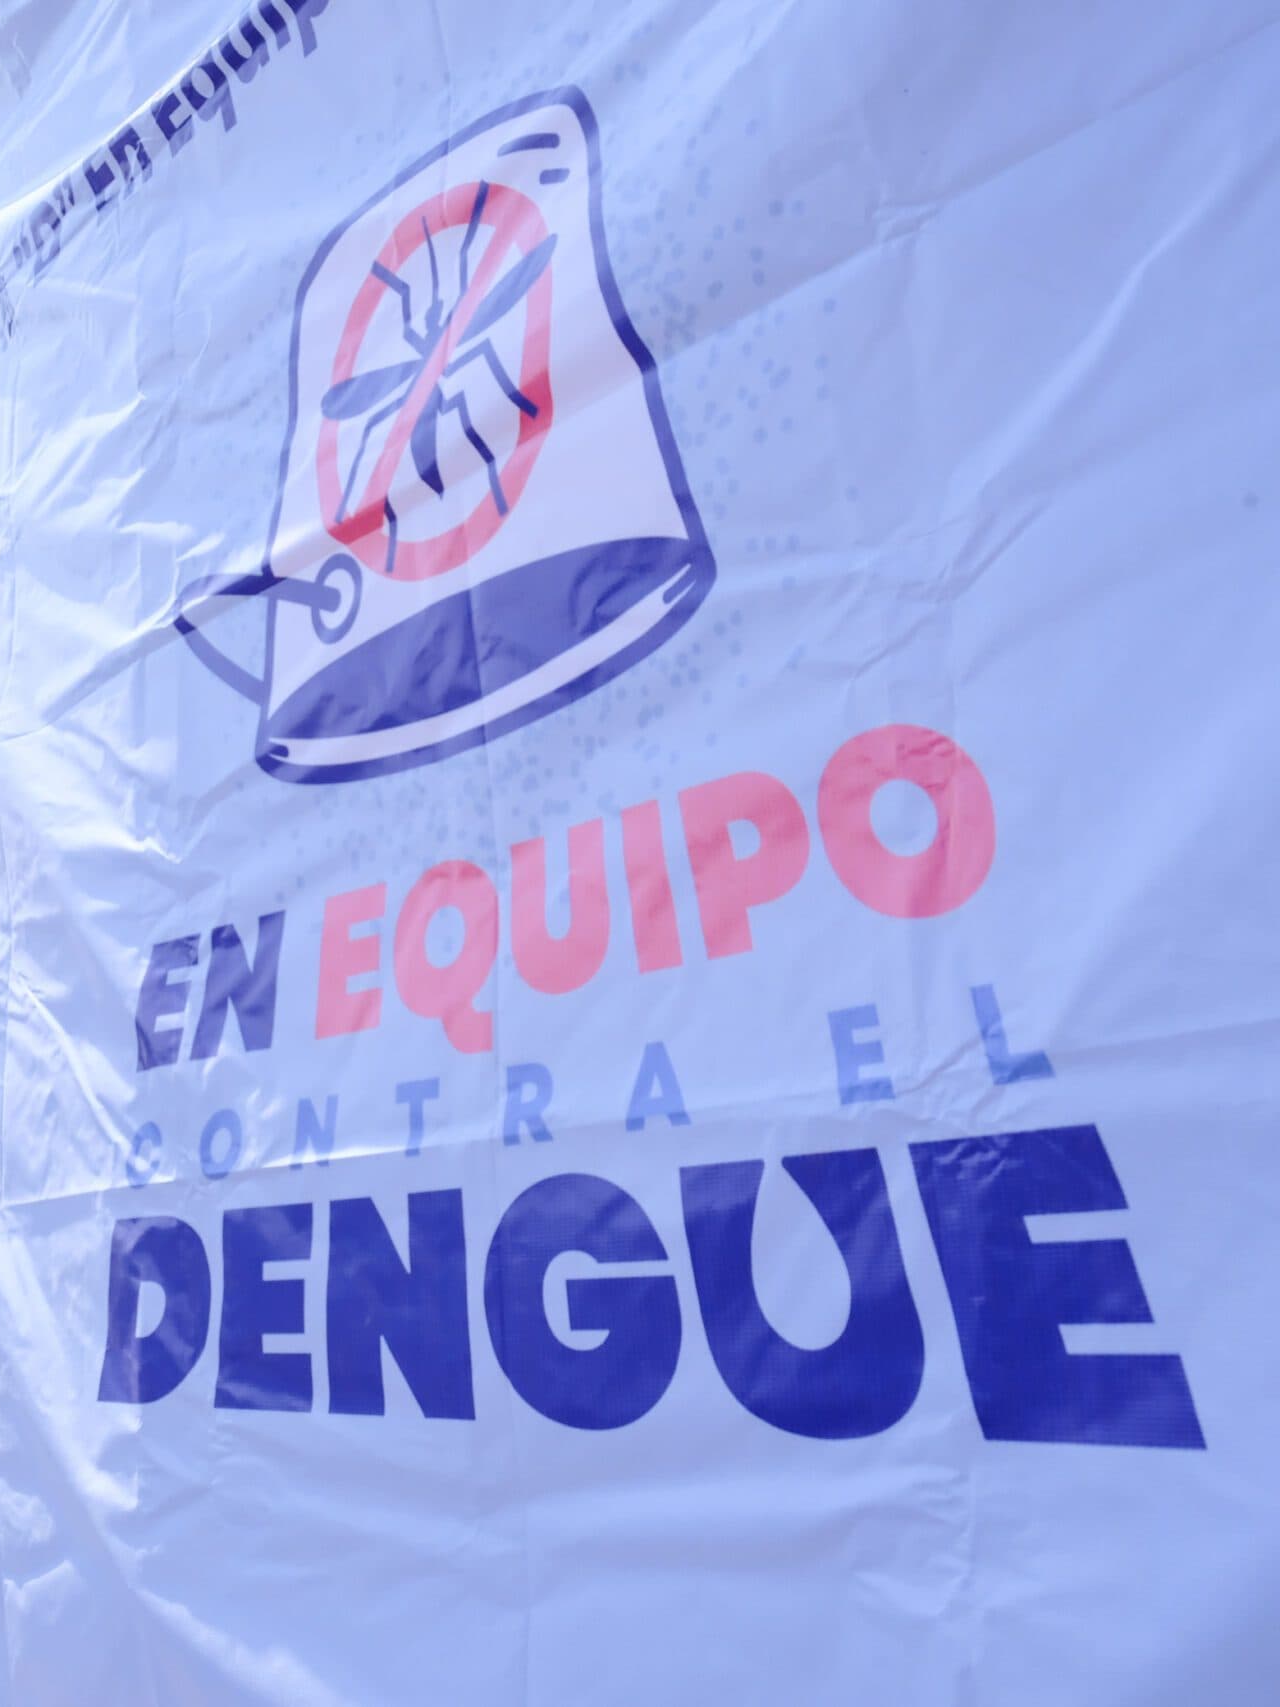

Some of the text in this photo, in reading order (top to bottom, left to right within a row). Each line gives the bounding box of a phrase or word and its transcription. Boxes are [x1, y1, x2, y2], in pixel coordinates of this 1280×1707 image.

[137, 724, 996, 1072] EN EQUIPO
[124, 983, 1056, 1188] CONTRA EL
[99, 1123, 1207, 1450] DENGUE
